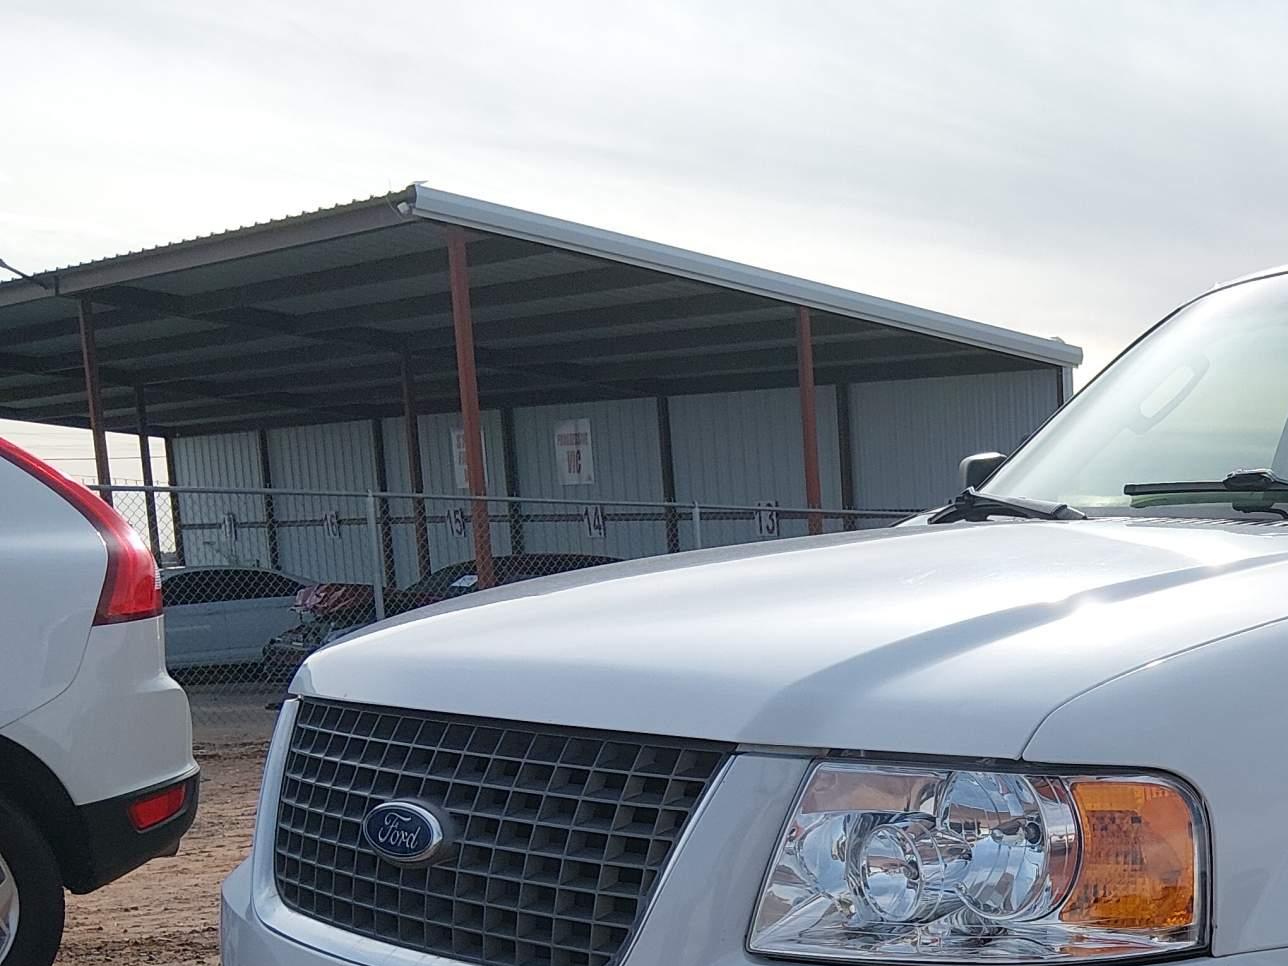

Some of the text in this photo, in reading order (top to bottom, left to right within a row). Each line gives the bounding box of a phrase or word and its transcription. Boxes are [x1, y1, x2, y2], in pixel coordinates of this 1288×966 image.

[447, 509, 463, 536] 15
[584, 507, 603, 536] 14
[754, 501, 776, 534] 13
[378, 812, 421, 849] Ford
